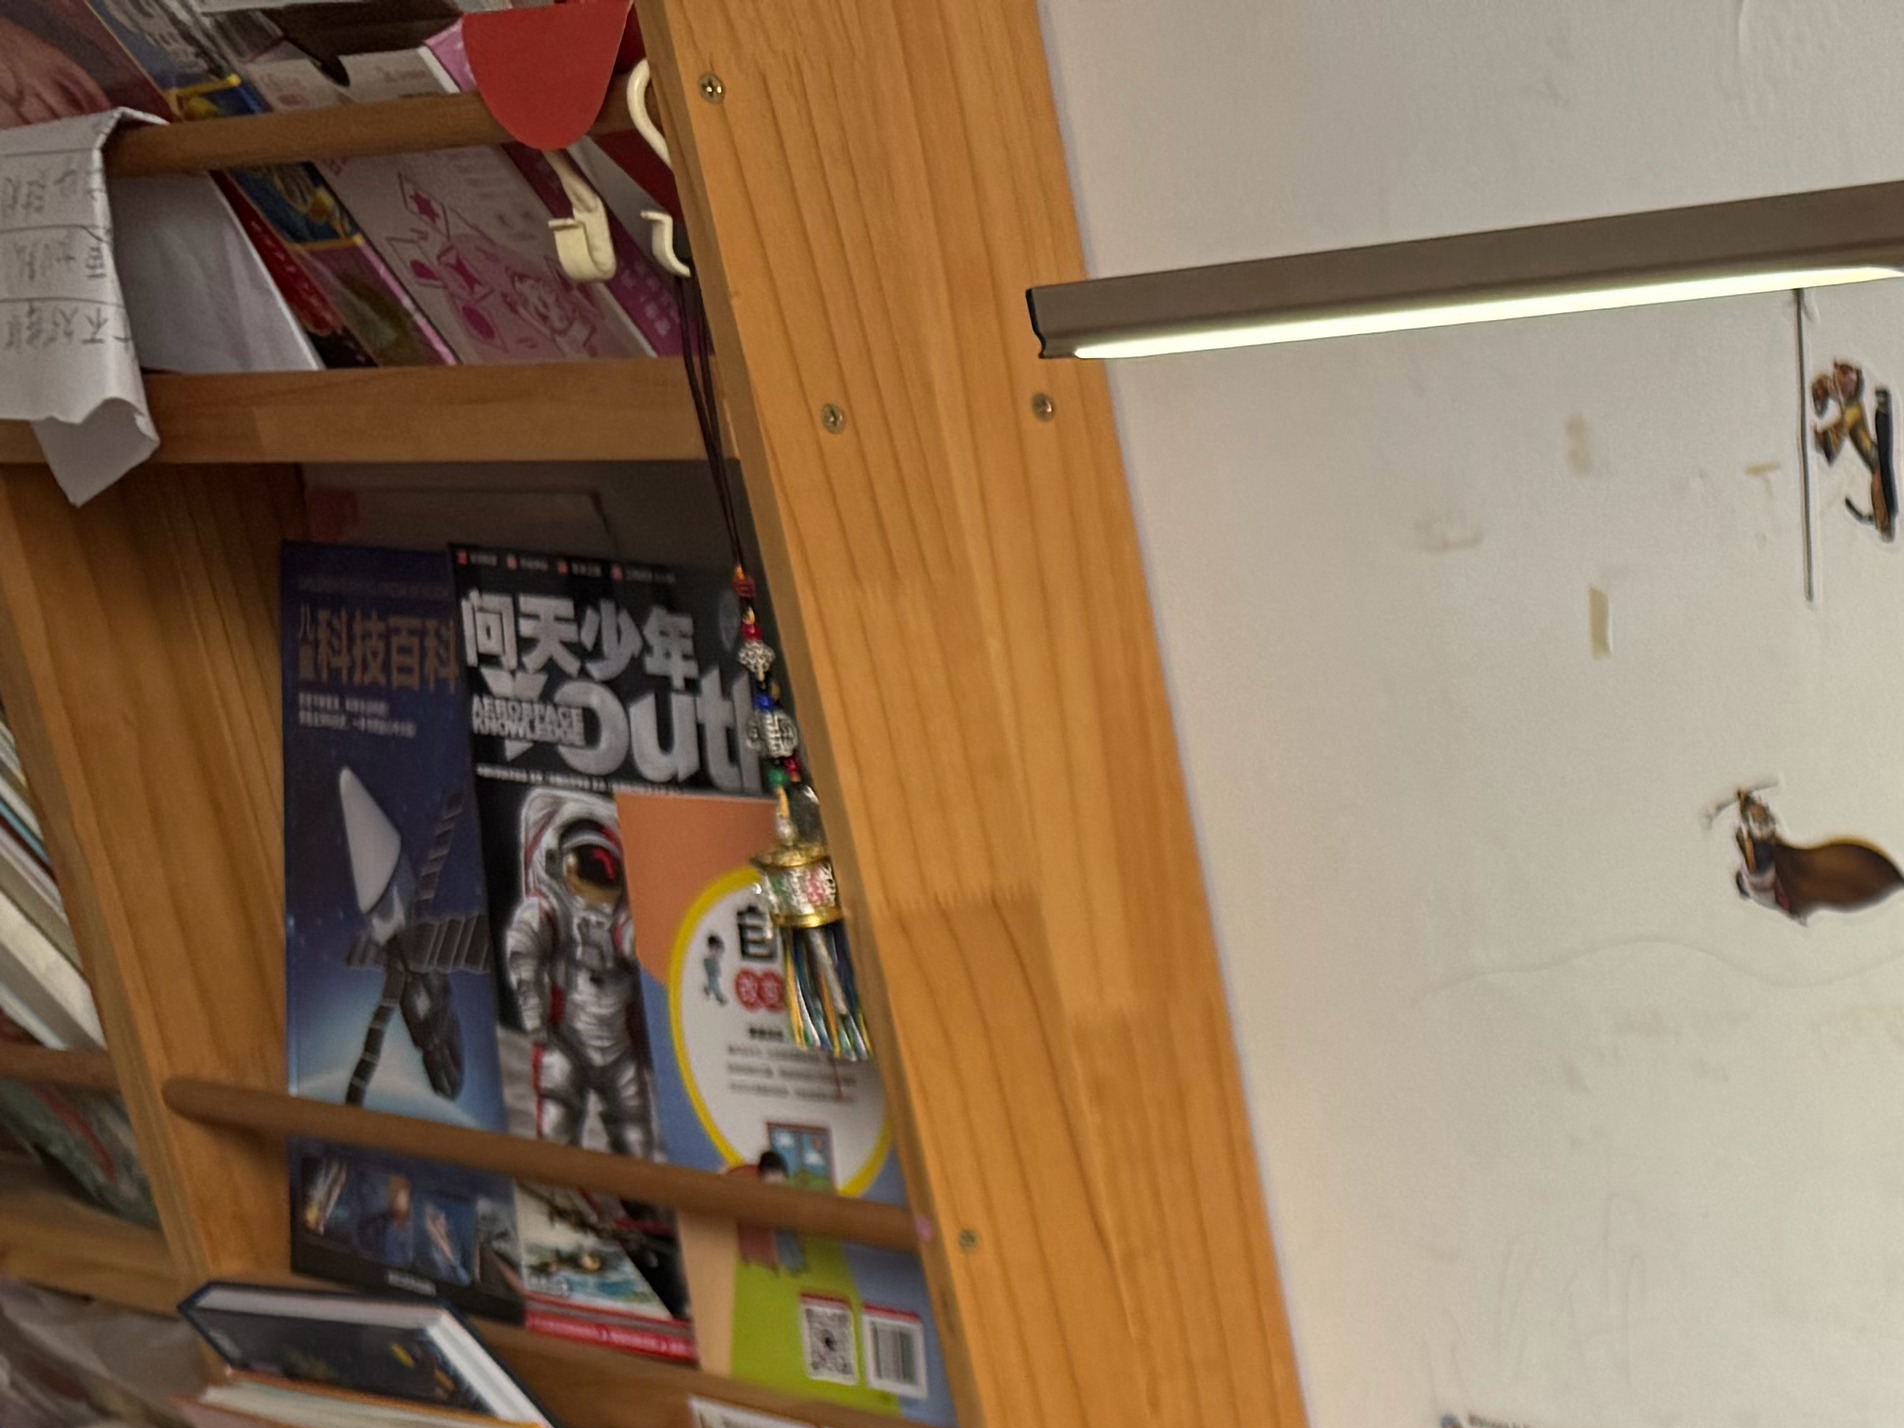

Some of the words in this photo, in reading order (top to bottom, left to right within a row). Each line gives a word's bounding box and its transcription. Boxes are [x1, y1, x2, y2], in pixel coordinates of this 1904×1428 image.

[316, 607, 461, 694] 科技百科
[460, 588, 700, 690] 问天少年
[472, 697, 583, 727] AEROSPACE
